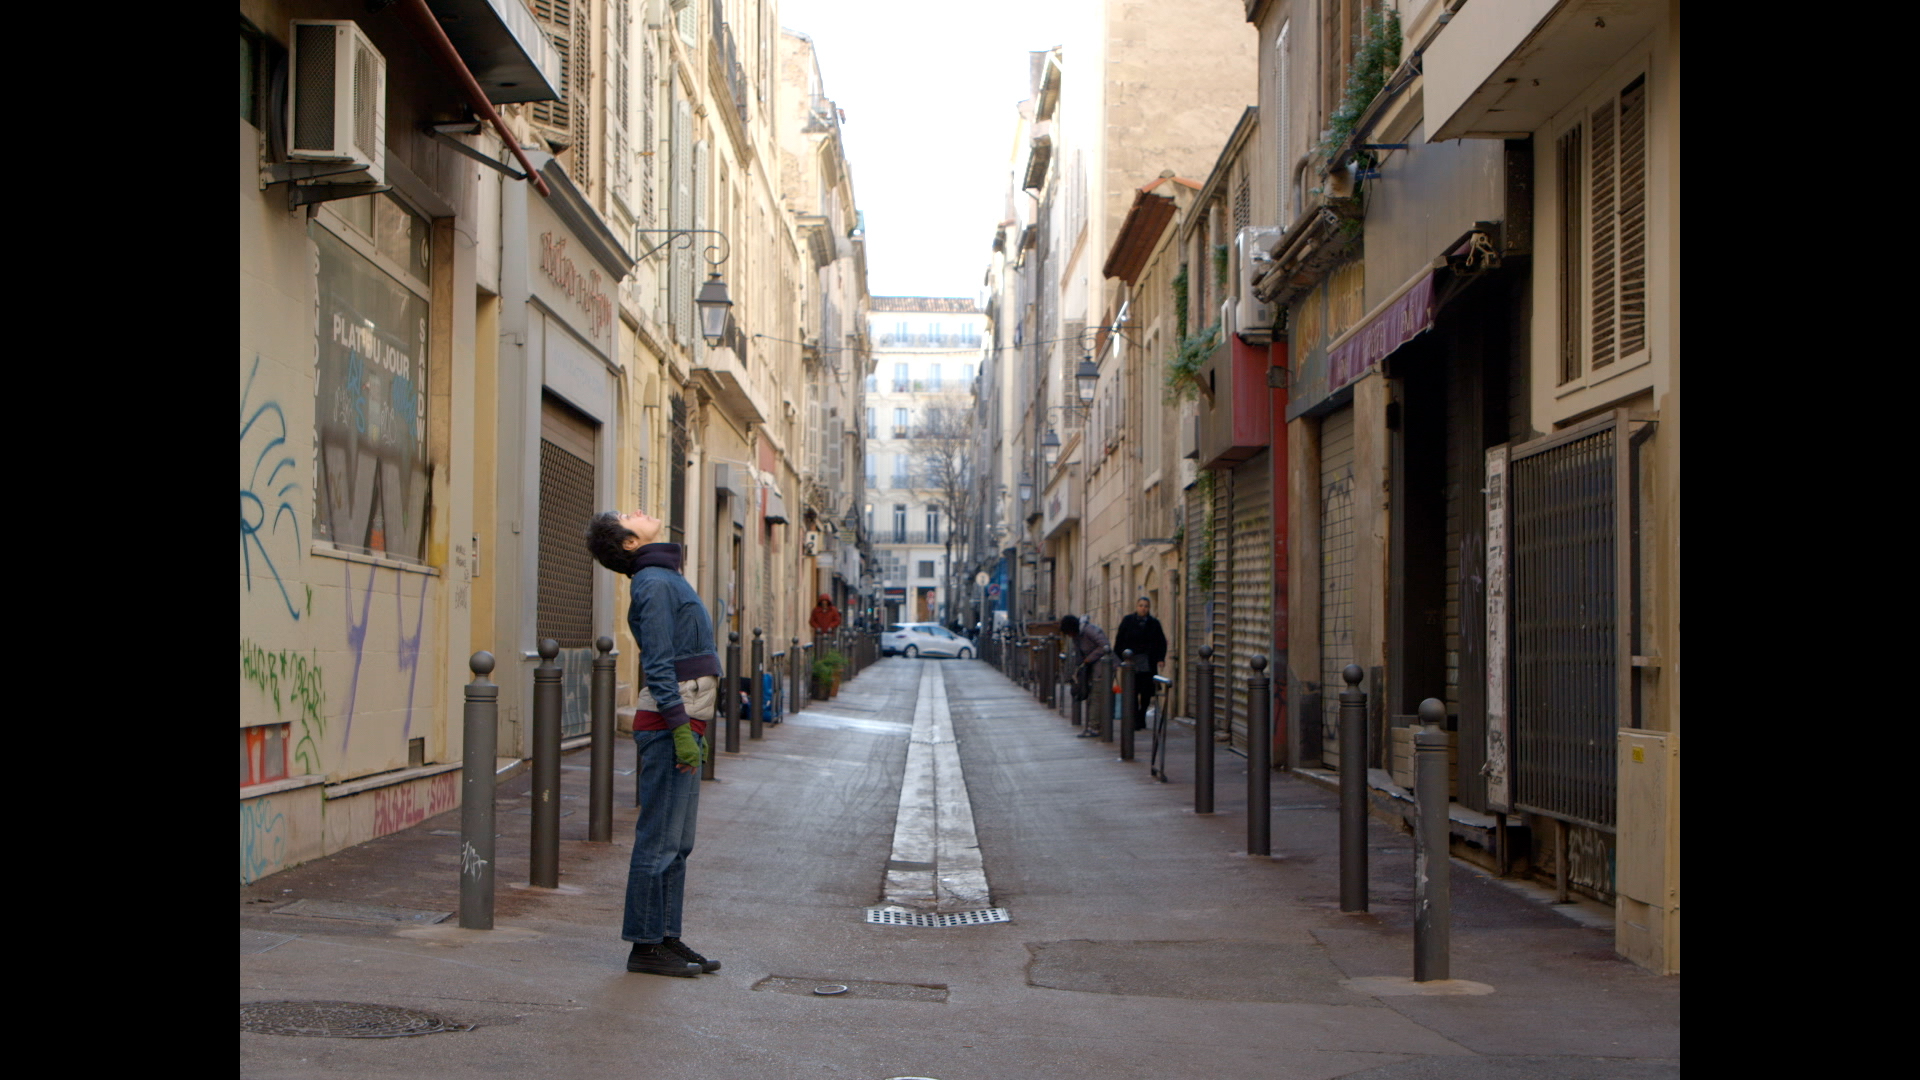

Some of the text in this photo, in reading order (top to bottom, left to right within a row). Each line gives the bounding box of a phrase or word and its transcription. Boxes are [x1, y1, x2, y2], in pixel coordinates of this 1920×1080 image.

[333, 313, 410, 381] PLAT DU JOUR
